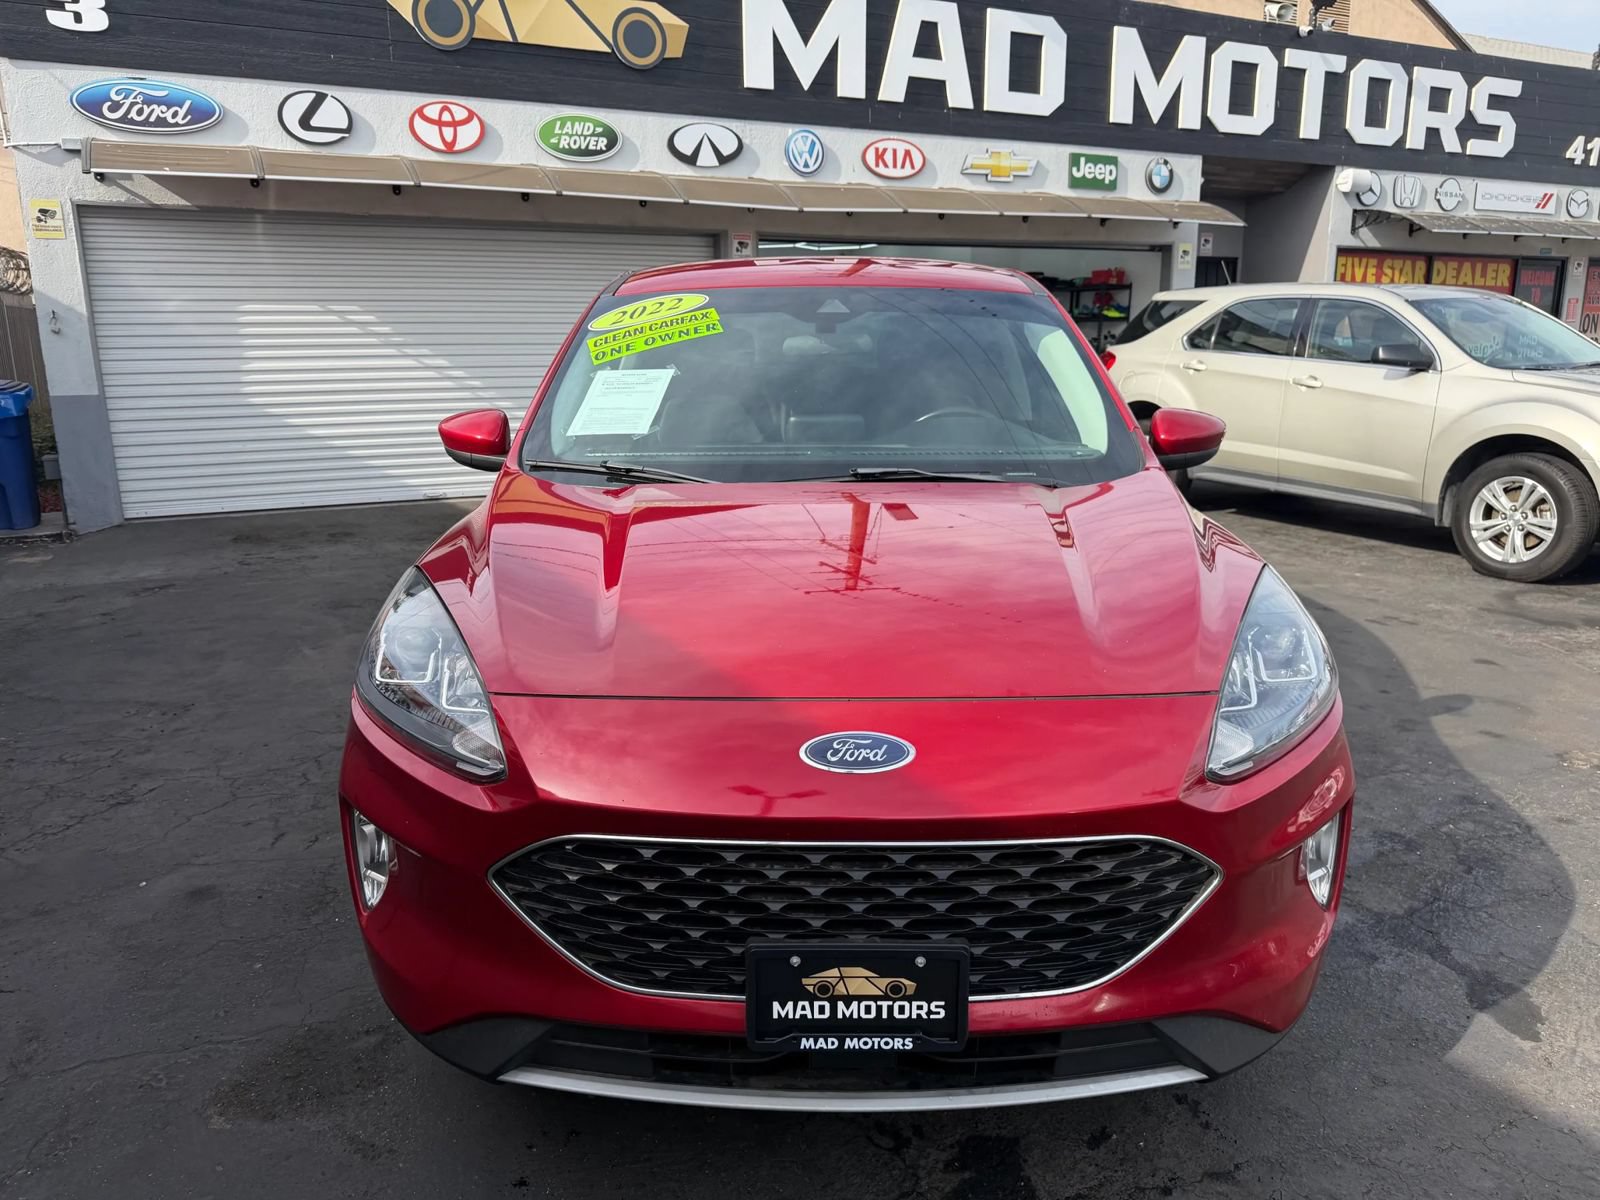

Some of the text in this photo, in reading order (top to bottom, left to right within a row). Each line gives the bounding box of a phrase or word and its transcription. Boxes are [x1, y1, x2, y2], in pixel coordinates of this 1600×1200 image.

[743, 0, 1523, 158] MAD MOTORS
[102, 85, 192, 126] Ford
[554, 120, 595, 136] LAND
[560, 134, 607, 151] ROVER
[1565, 135, 1600, 166] 41
[875, 147, 915, 170] KIA
[1072, 156, 1117, 184] Jeep
[1437, 190, 1463, 199] NISSAN
[1481, 192, 1543, 204] DODGE
[1336, 257, 1510, 287] FIVE STAR DEALER
[610, 297, 684, 326] 2022
[593, 311, 712, 349] CLEAN CARFAX
[594, 322, 719, 361] ONE OWNER
[827, 738, 887, 761] Ford
[772, 1000, 946, 1020] MAD MOTORS
[800, 1037, 913, 1050] MAD MOTORS
